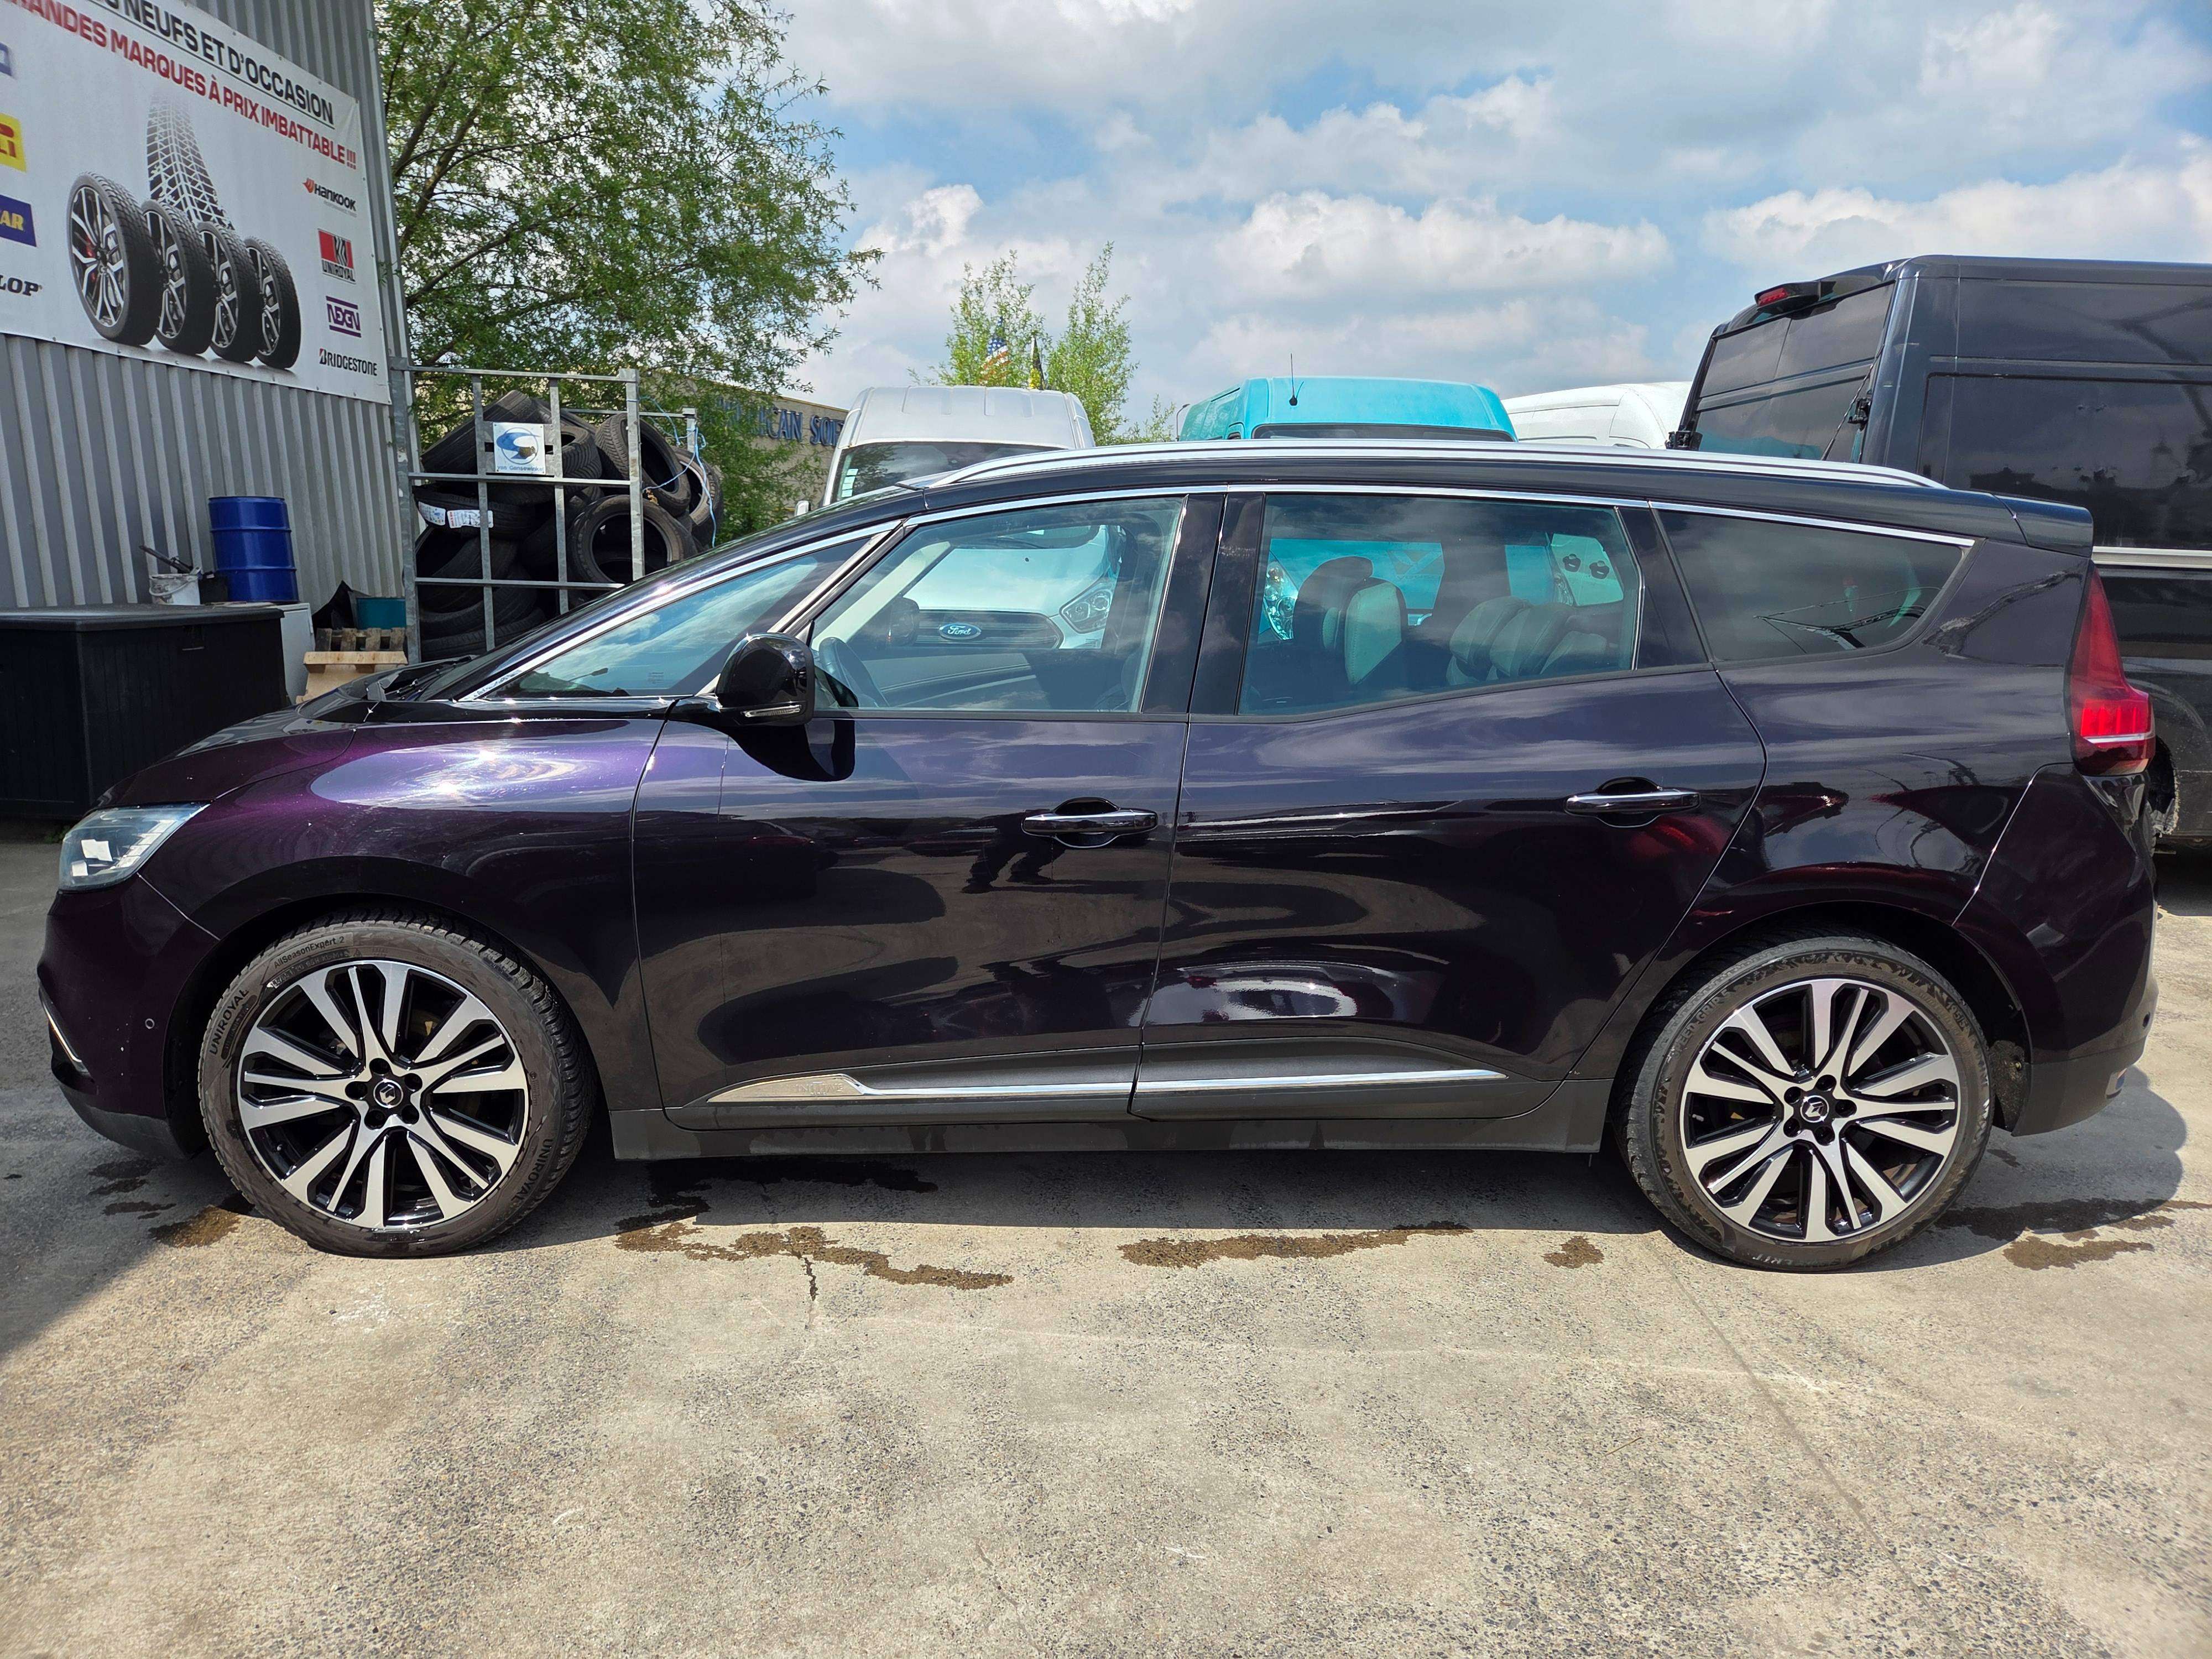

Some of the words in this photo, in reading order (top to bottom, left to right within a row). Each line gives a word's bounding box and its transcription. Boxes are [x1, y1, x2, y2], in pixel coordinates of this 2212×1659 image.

[11, 0, 107, 48] ANDES
[111, 29, 206, 96] MARQUES
[208, 74, 221, 105] À
[223, 86, 259, 123] PRIX
[262, 106, 345, 164] IMBATTABLE
[124, 0, 199, 52] NEUFS
[201, 30, 225, 66] ET
[227, 46, 334, 125] D'OCCASION
[319, 348, 378, 376] BRIDGESTONE
[947, 625, 972, 635] Ford
[273, 938, 336, 968] AllSeasonExpert
[340, 936, 345, 944] 2
[209, 988, 249, 1055] UNIROYAL
[510, 1138, 554, 1202] UNIROYAL
